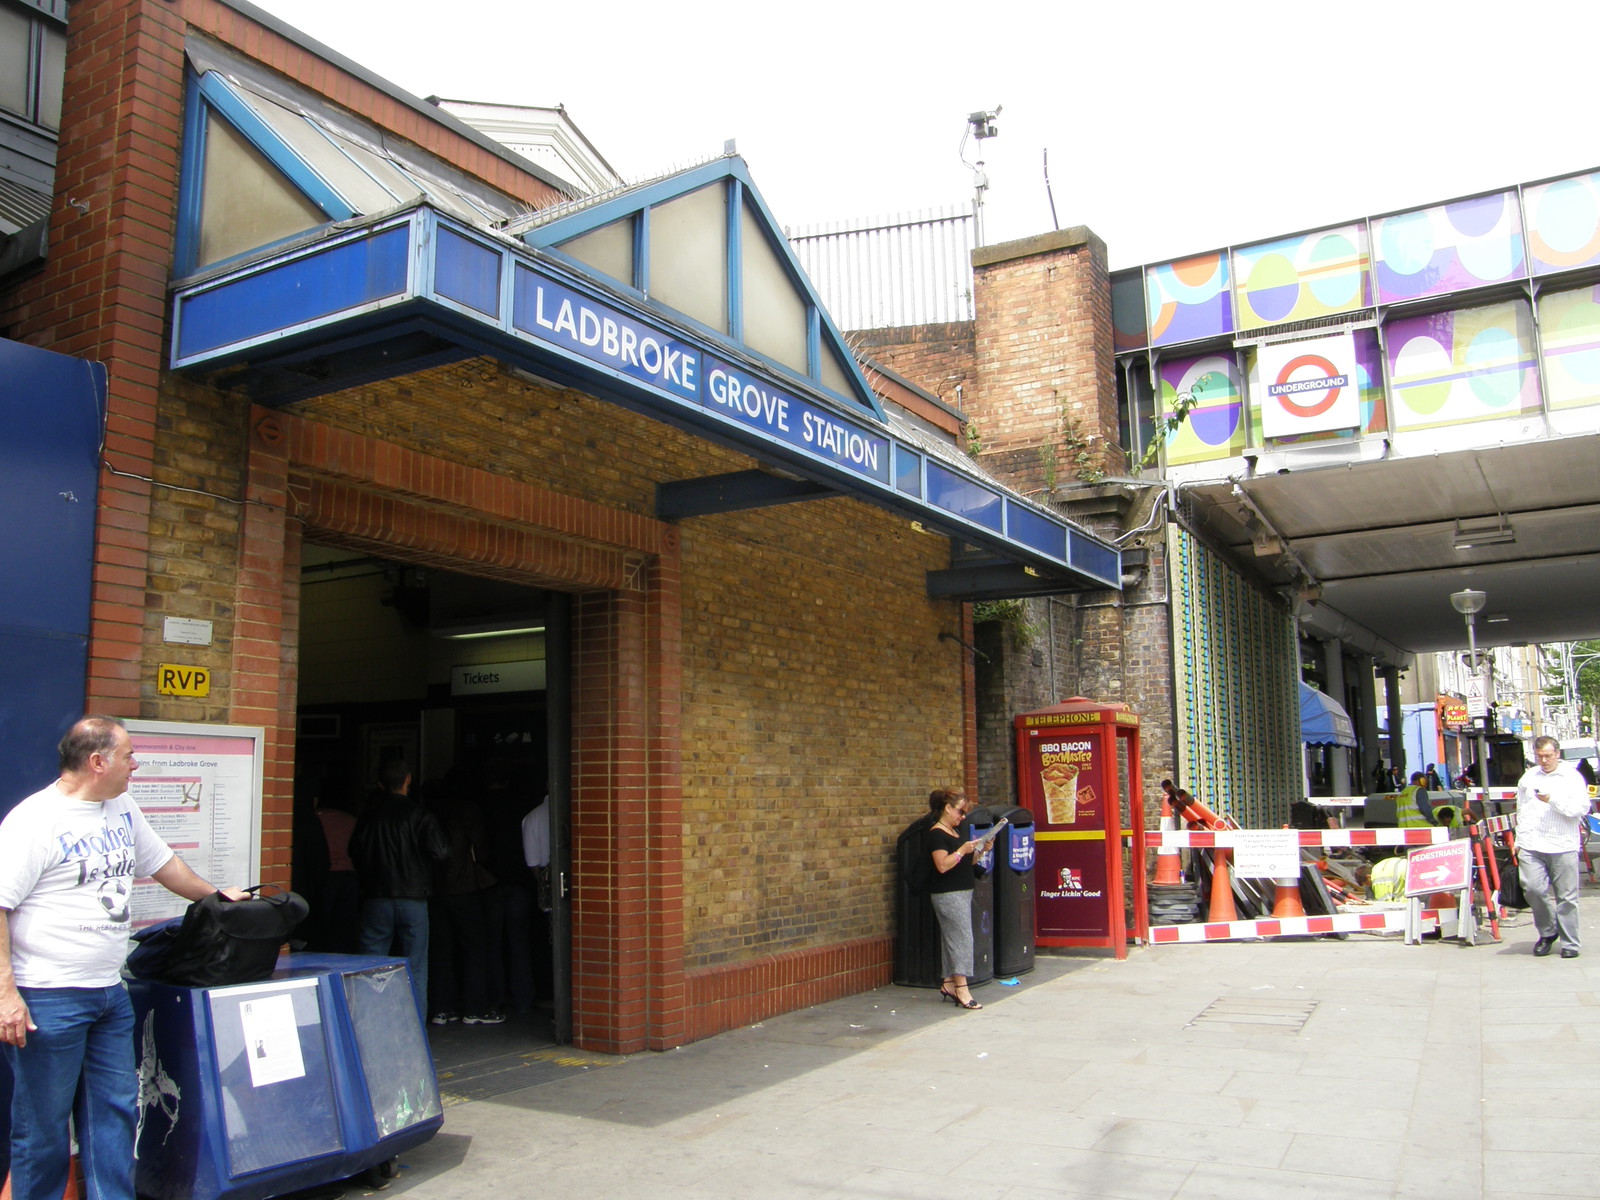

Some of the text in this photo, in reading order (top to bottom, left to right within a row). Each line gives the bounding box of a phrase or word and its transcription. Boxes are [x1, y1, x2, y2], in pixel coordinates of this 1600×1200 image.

[536, 286, 879, 471] LADBROKE GROVE STATION
[1272, 377, 1345, 395] UNDERGROUND
[163, 669, 206, 690] RVP
[463, 672, 500, 685] Tickets
[1030, 713, 1096, 726] TELEPHONE
[1042, 743, 1059, 753] BBQ
[1061, 741, 1091, 752] BACON
[56, 811, 135, 864] Football
[1411, 847, 1464, 863] PEDESTRIANS
[75, 848, 135, 886] Is Life
[1040, 890, 1060, 898] Finger
